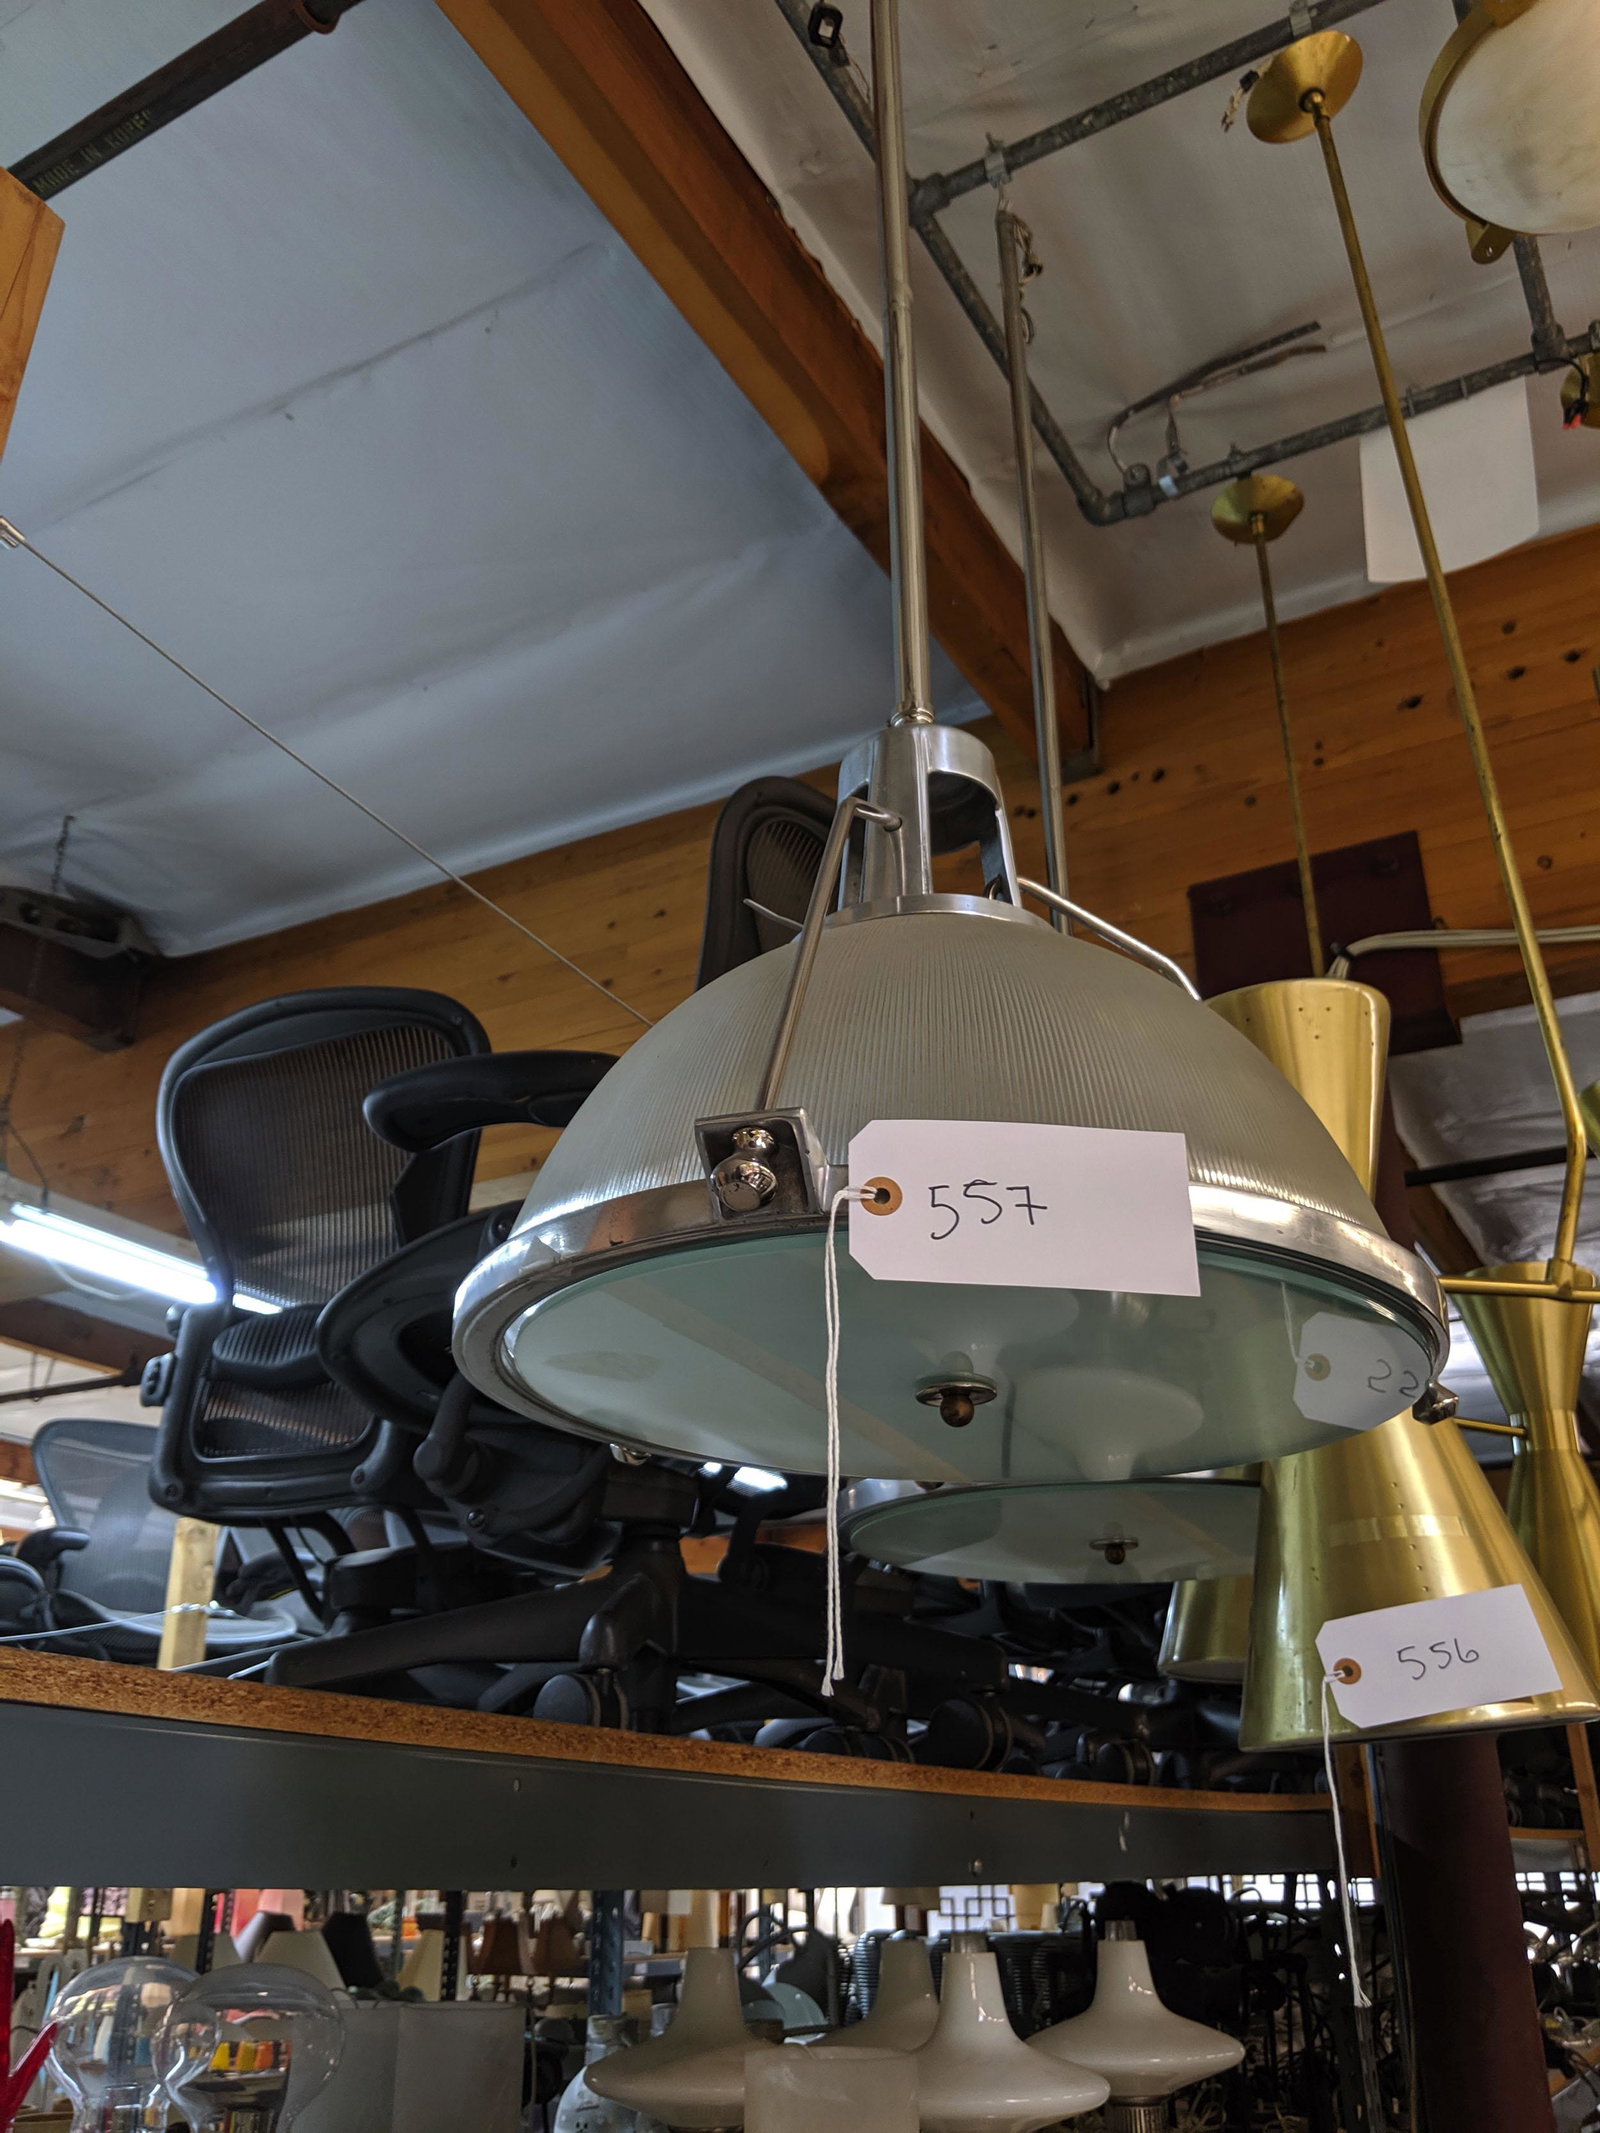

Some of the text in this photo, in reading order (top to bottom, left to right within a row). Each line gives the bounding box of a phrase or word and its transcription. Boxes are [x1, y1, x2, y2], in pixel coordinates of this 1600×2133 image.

[32, 159, 79, 193] MADE
[80, 144, 103, 164] IN
[928, 1179, 1048, 1240] 557
[1397, 1638, 1480, 1681] 556
